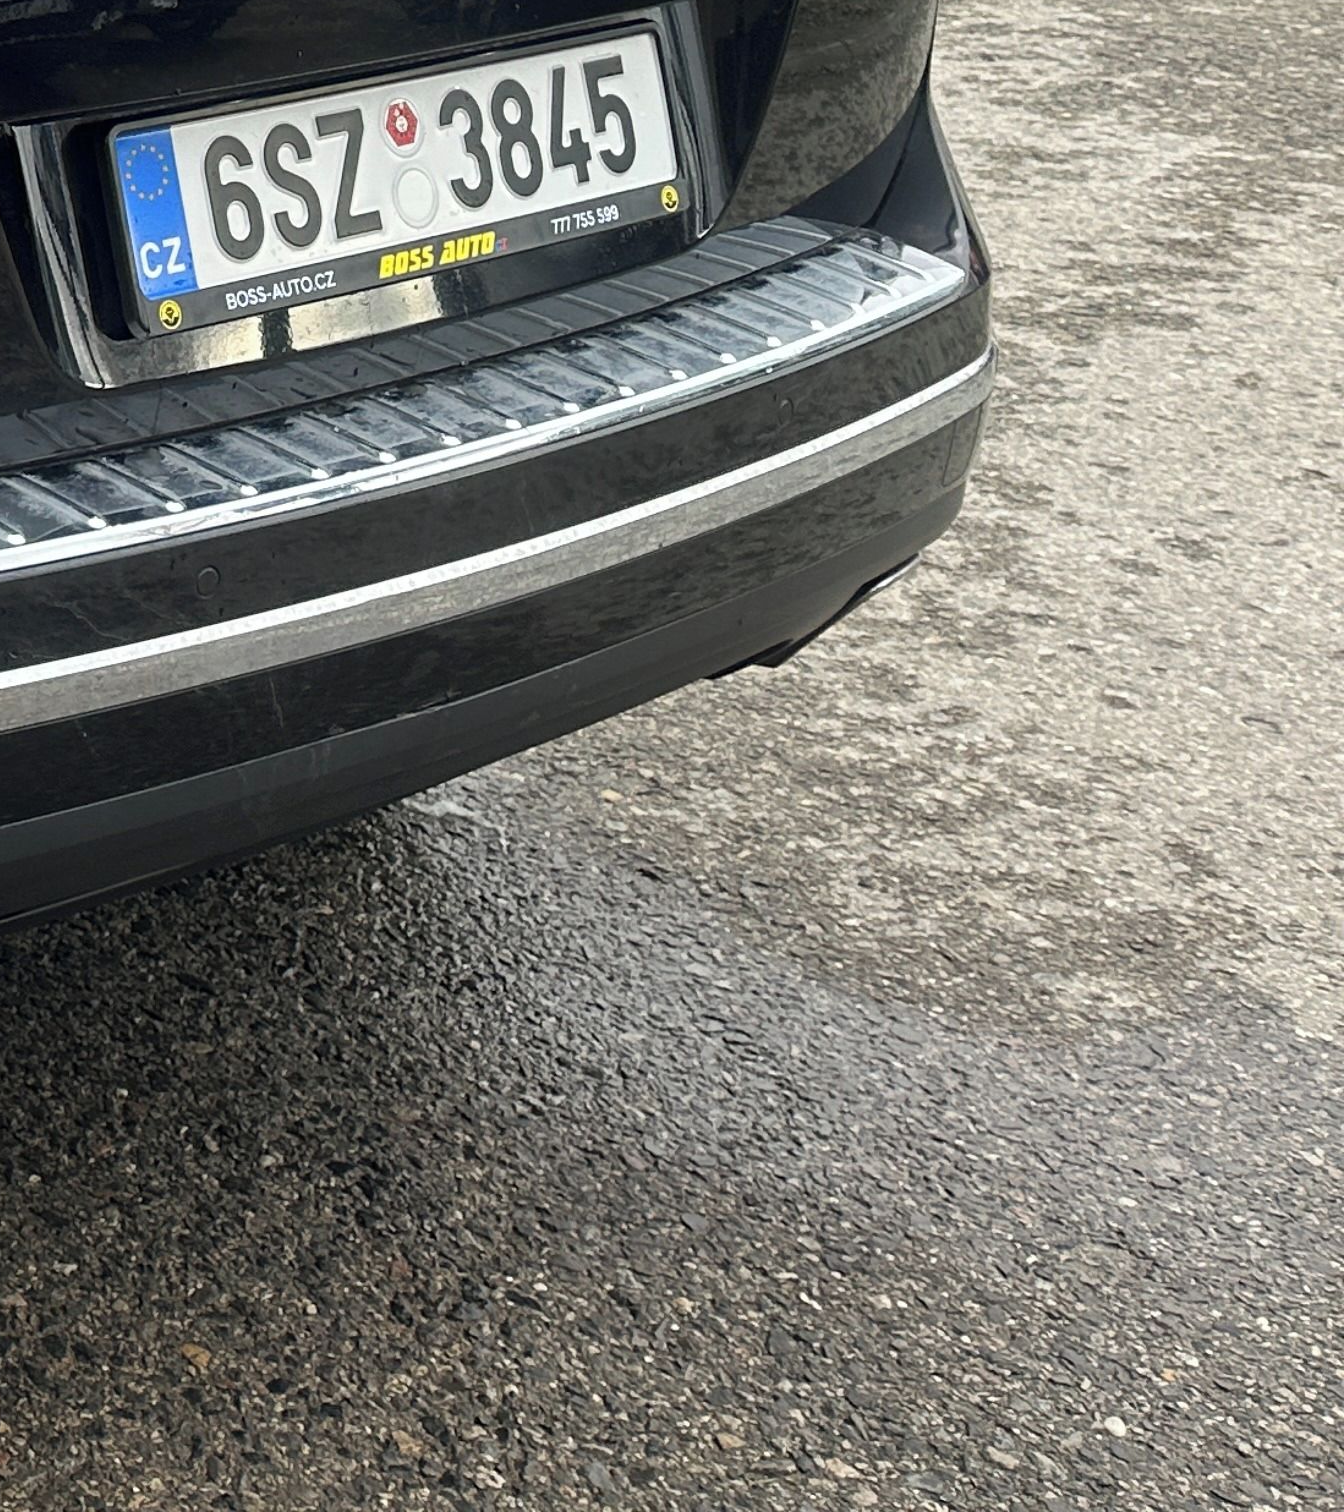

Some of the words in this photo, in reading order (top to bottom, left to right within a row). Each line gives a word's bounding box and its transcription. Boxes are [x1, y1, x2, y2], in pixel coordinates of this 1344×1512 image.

[202, 107, 383, 261] 6SZ
[437, 53, 638, 209] 3845
[550, 212, 571, 235] 777
[574, 207, 595, 233] 755
[597, 204, 620, 226] 599
[140, 235, 187, 279] CZ
[378, 245, 434, 280] BOSS
[439, 230, 496, 266] AUTO
[225, 270, 337, 311] BOSS-AUTO.CZ
